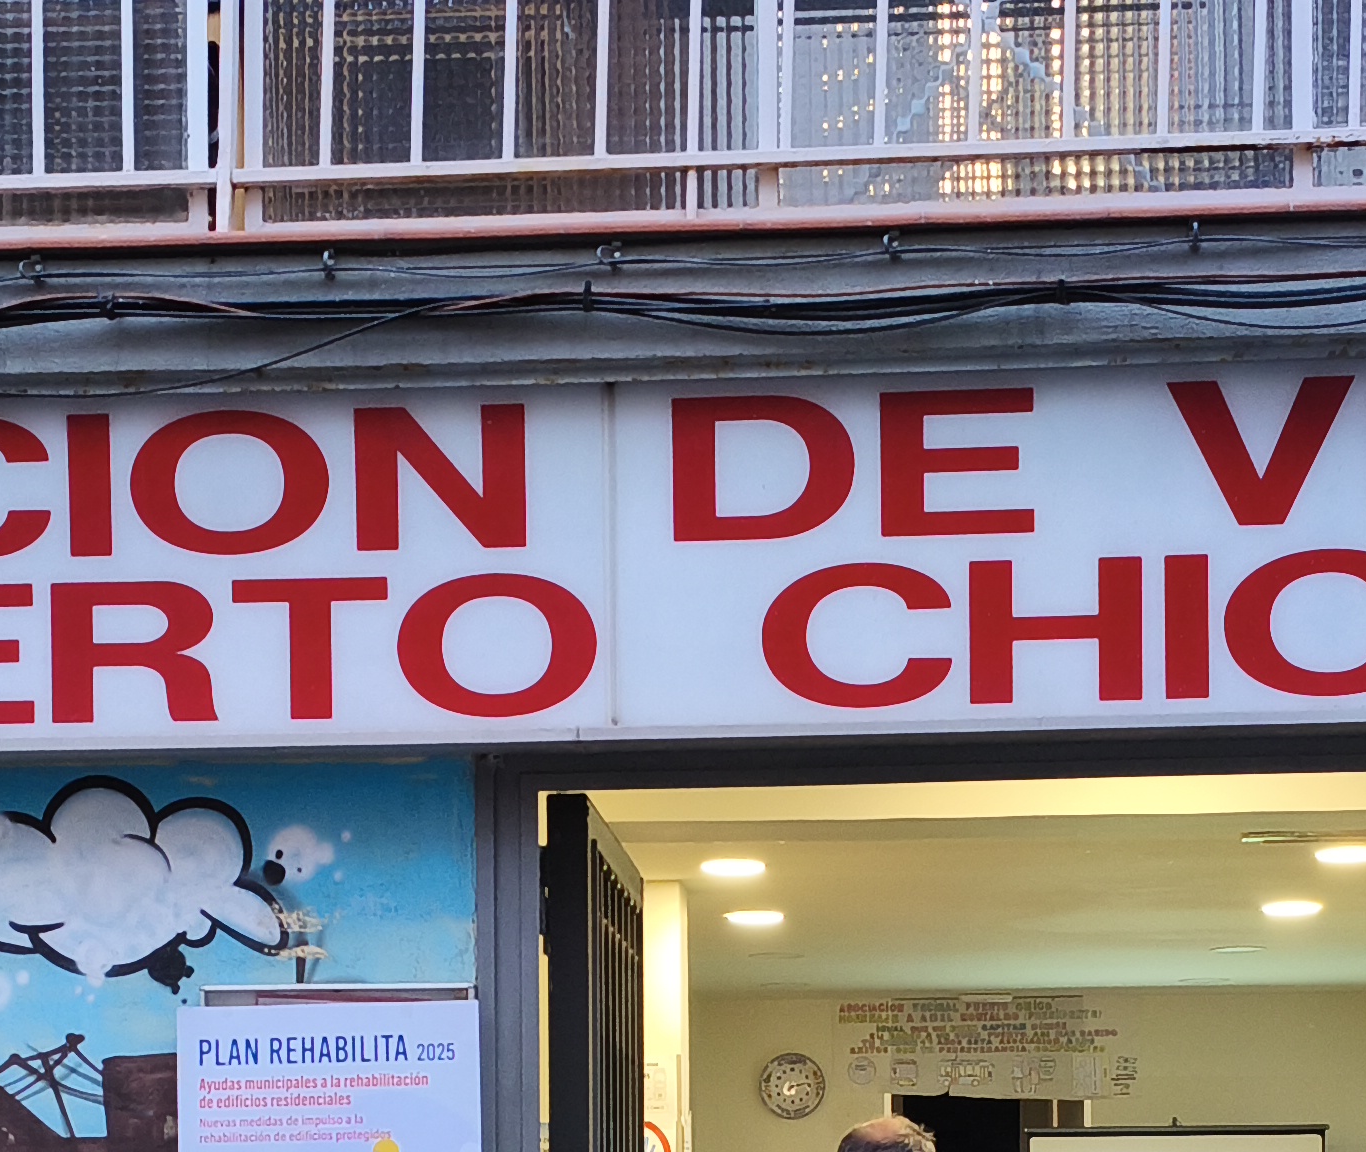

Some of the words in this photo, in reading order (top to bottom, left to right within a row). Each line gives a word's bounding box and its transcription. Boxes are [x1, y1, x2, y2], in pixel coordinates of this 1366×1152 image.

[673, 396, 1035, 542] DE
[199, 1038, 259, 1066] PLAN
[269, 1034, 408, 1064] REHABILITA
[417, 1042, 456, 1062] 2025
[199, 1078, 242, 1094] Ayudas
[245, 1075, 318, 1092] municipales
[320, 1078, 328, 1088] a
[330, 1074, 341, 1088] la
[344, 1071, 429, 1087] rehabilitación
[199, 1095, 214, 1109] de
[216, 1094, 268, 1108] edificios
[270, 1092, 352, 1107] residenciales
[199, 1117, 237, 1128] Nuevas
[239, 1115, 283, 1127] medidas
[285, 1115, 300, 1126] de
[301, 1114, 343, 1128] impulso
[345, 1117, 352, 1125] a
[354, 1114, 364, 1125] la
[199, 1131, 271, 1144] rehabilitación
[273, 1131, 286, 1142] de
[289, 1129, 333, 1141] edificios
[336, 1129, 392, 1143] protegidos
